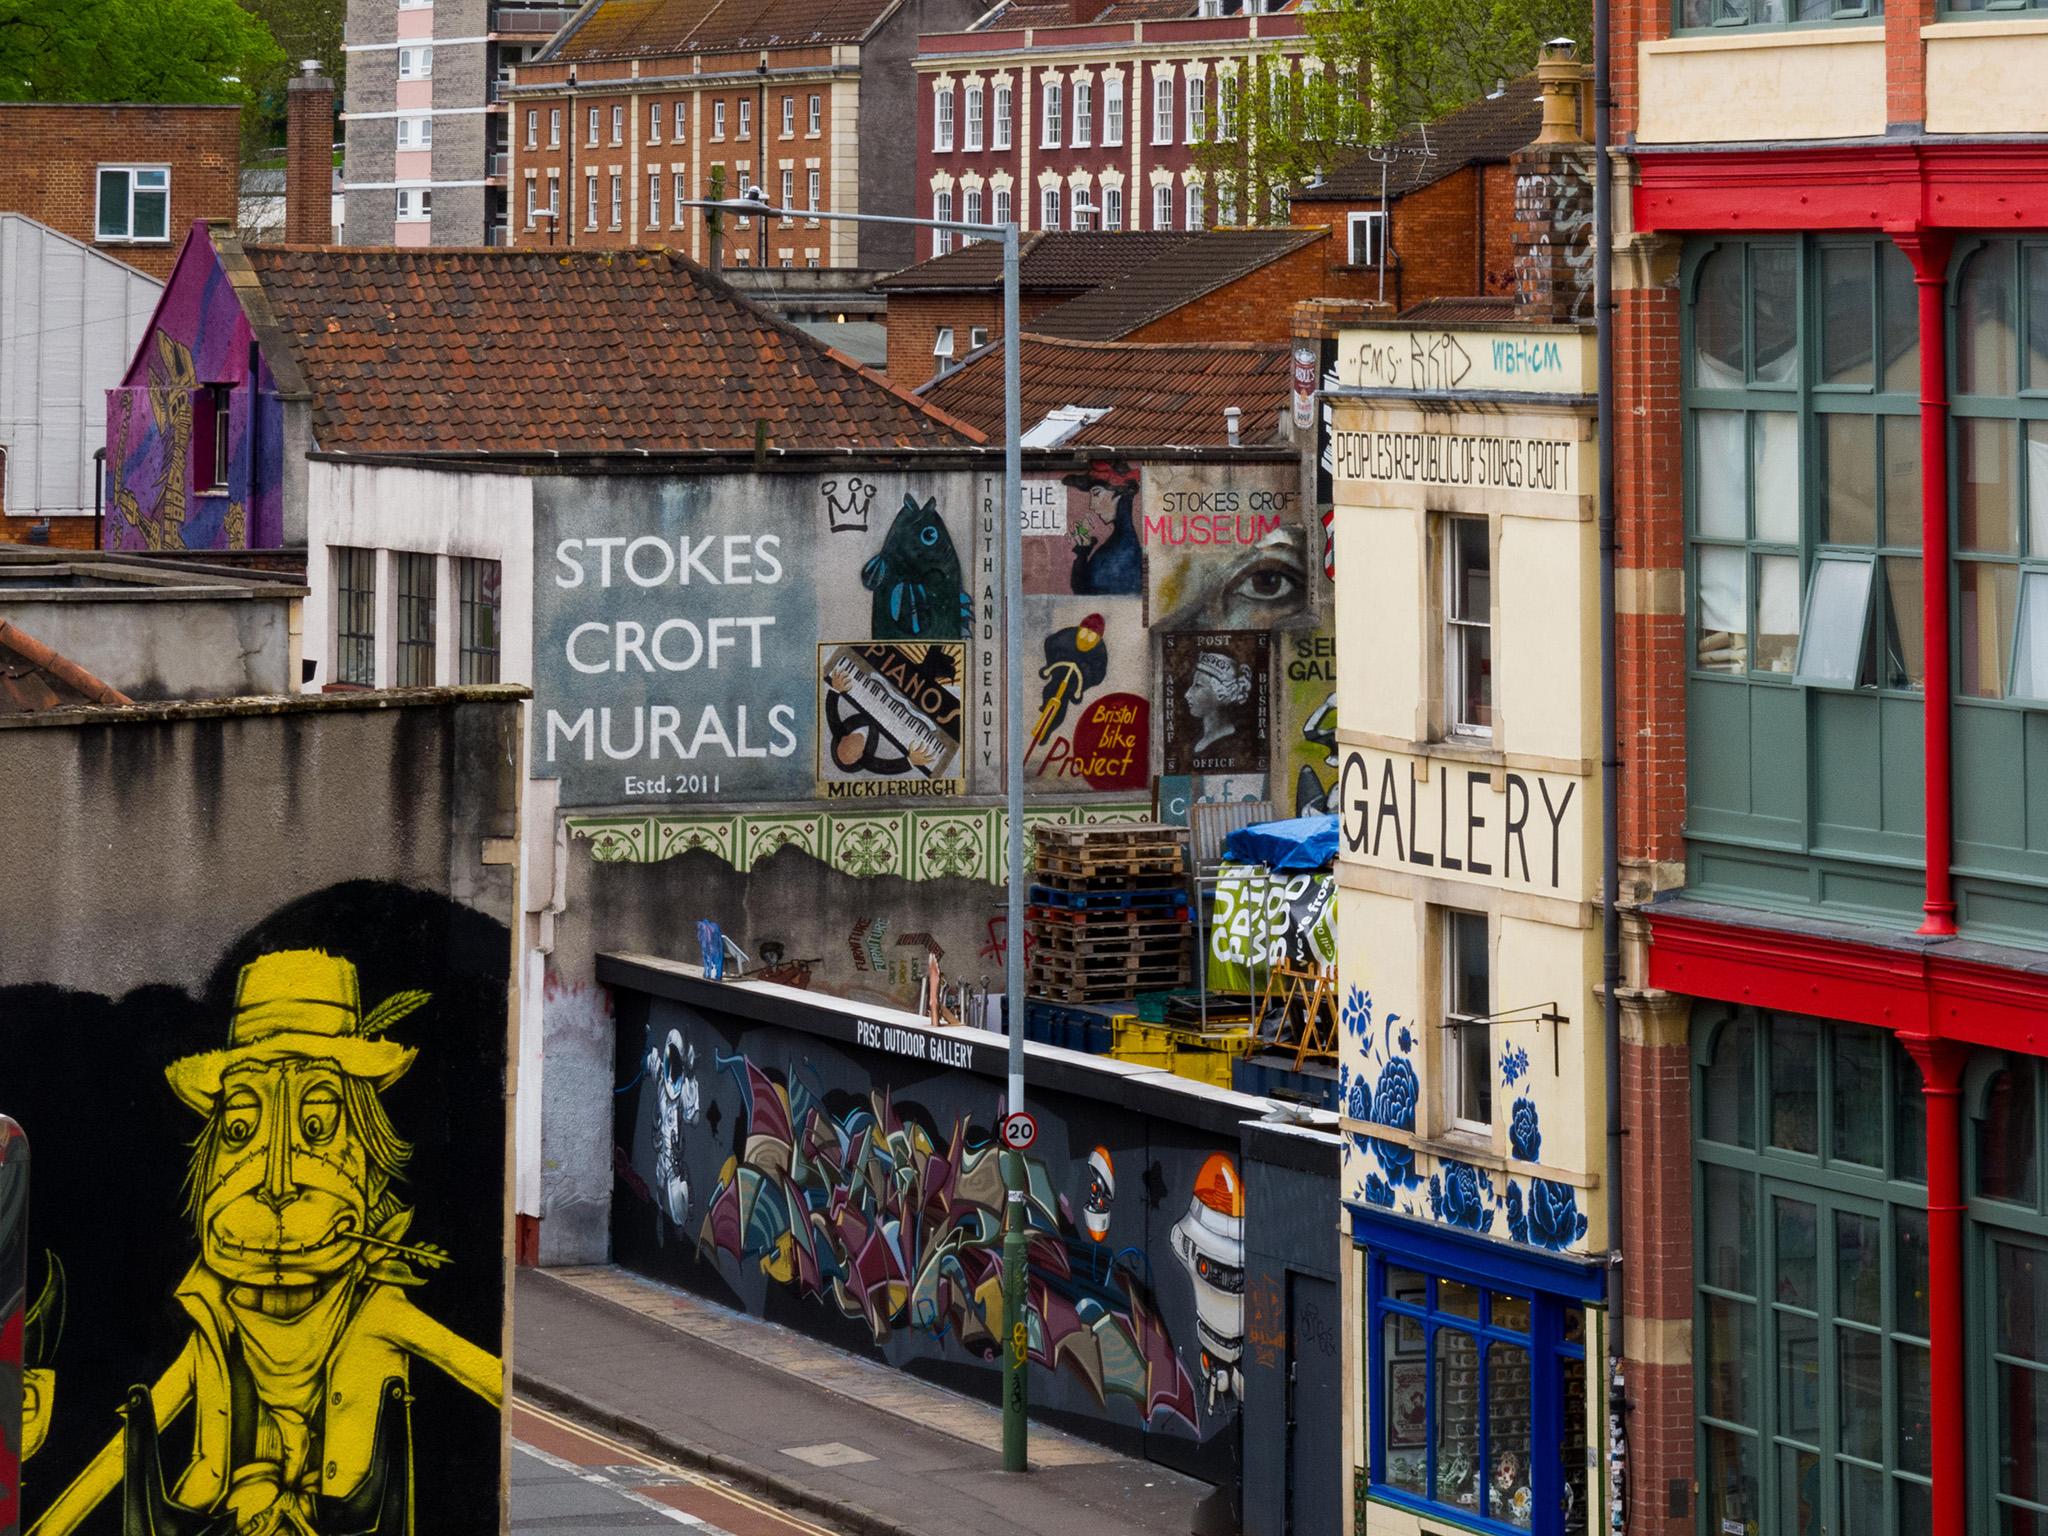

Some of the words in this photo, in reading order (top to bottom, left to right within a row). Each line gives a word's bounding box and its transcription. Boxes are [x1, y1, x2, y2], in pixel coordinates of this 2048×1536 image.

[1336, 432, 1392, 480] PEOPLES
[1394, 434, 1459, 484] REPUBLIC
[1461, 437, 1476, 485] OF
[1478, 438, 1523, 488] STOKES
[1527, 440, 1571, 491] CROFT
[1163, 492, 1239, 512] STOKES
[1249, 492, 1302, 511] CROF
[983, 478, 993, 573] TRUTH
[1144, 514, 1281, 545] MUSEUM
[555, 535, 783, 588] STOKES
[983, 586, 993, 640] AND
[565, 616, 776, 673] CROFT
[1197, 635, 1232, 646] POST
[864, 645, 960, 724] PIANOS
[1287, 660, 1336, 681] GAL
[983, 652, 993, 768] BEAUTY
[1092, 704, 1138, 724] Bristol
[1258, 673, 1267, 740] BUSHRA
[546, 704, 797, 762] MURALS
[1098, 724, 1136, 749] bike
[1037, 736, 1133, 777] Project
[1193, 758, 1235, 768] OFFICE
[625, 776, 672, 796] Estd.
[676, 775, 720, 794] 2011
[828, 780, 956, 797] MICKLEBURGH
[1340, 751, 1576, 888] GALLERY
[857, 1019, 881, 1049] PRSC
[884, 1029, 926, 1060] OUTDOOR
[929, 1037, 973, 1070] GALLERY
[1008, 1124, 1033, 1139] 20
